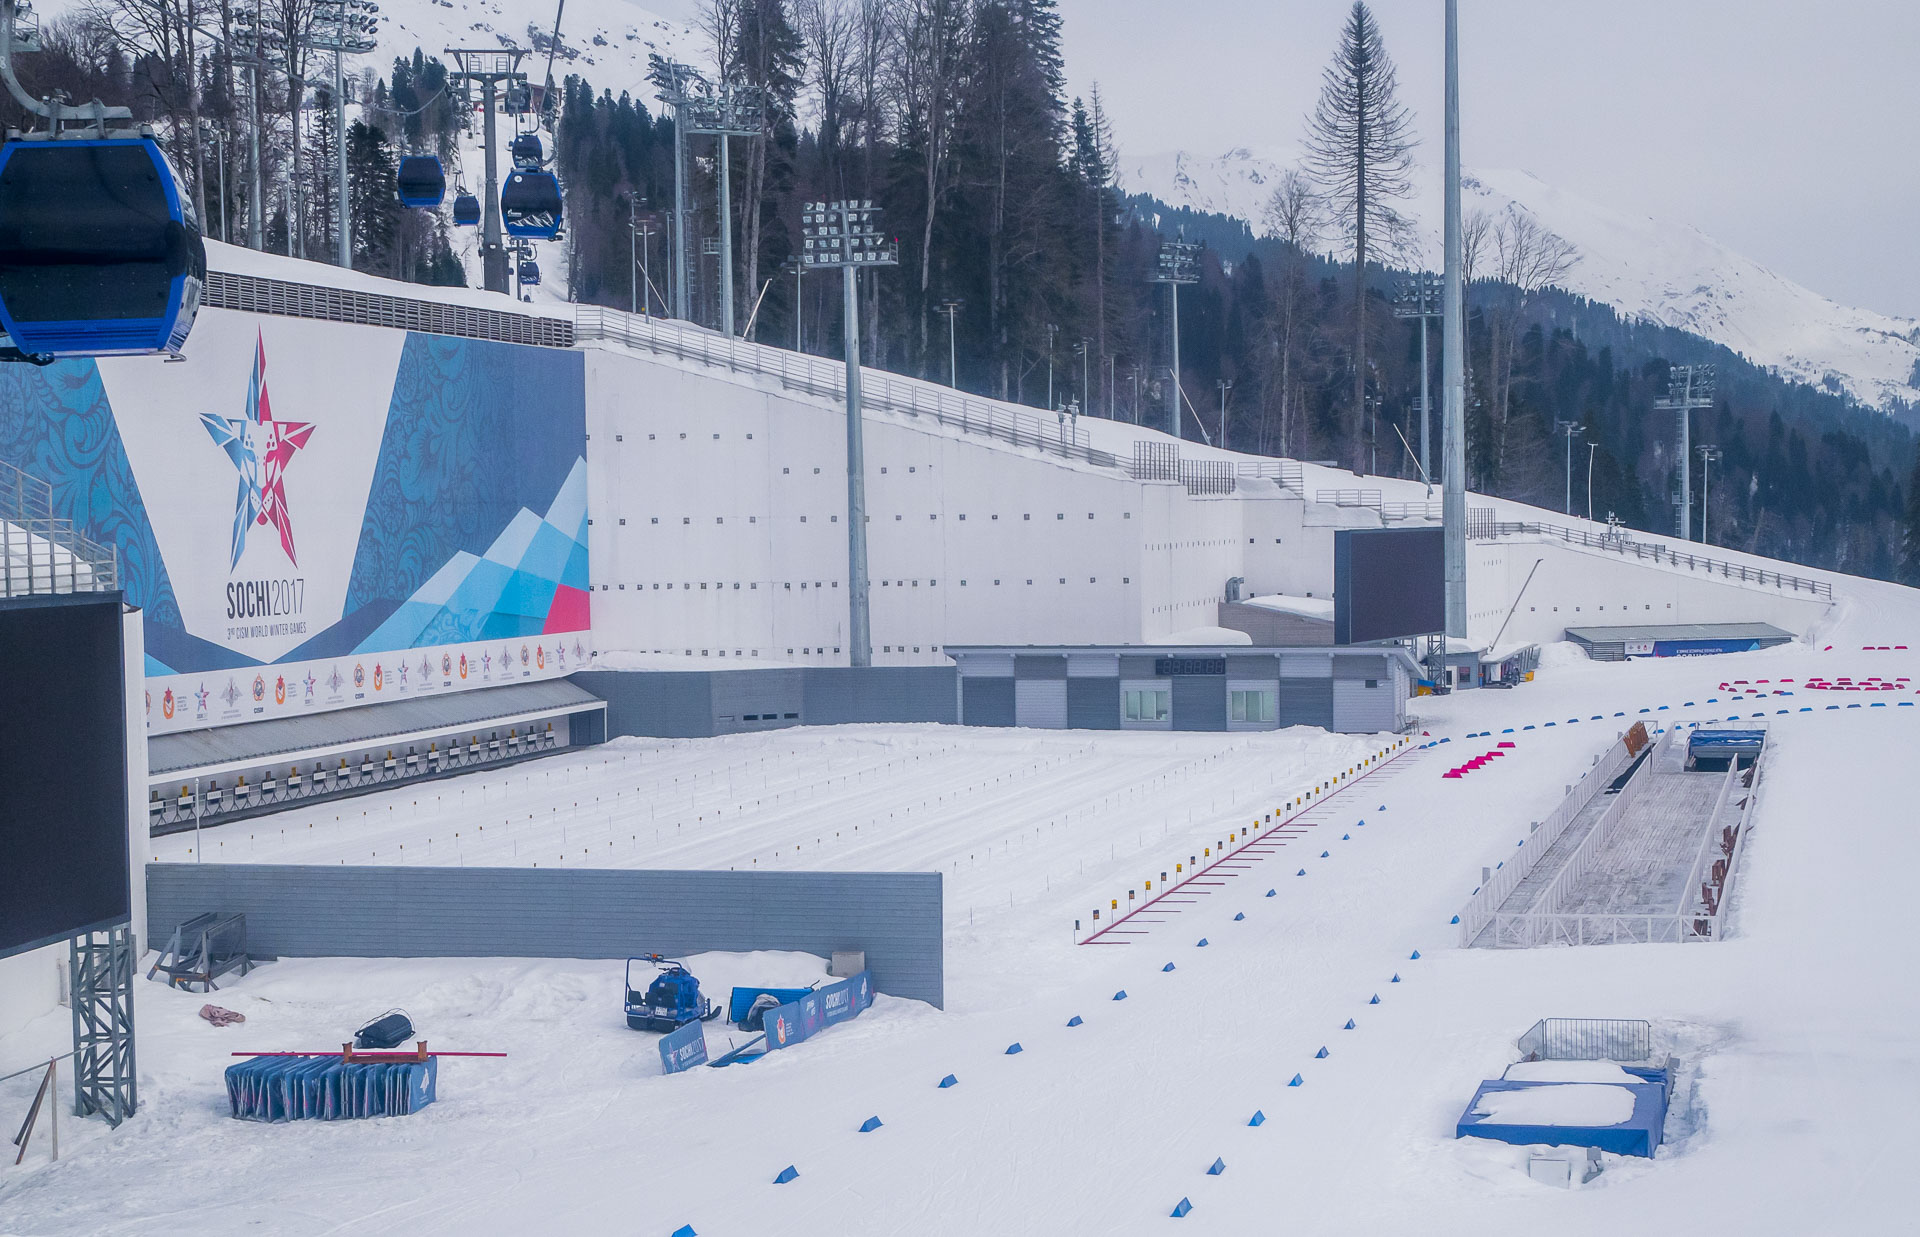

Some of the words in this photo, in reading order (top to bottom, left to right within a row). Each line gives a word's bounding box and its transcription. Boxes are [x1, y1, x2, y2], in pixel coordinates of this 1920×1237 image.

[236, 626, 249, 639] CISM
[250, 624, 268, 638] WORLD
[269, 623, 289, 636] WINTER
[289, 621, 307, 635] GAMES
